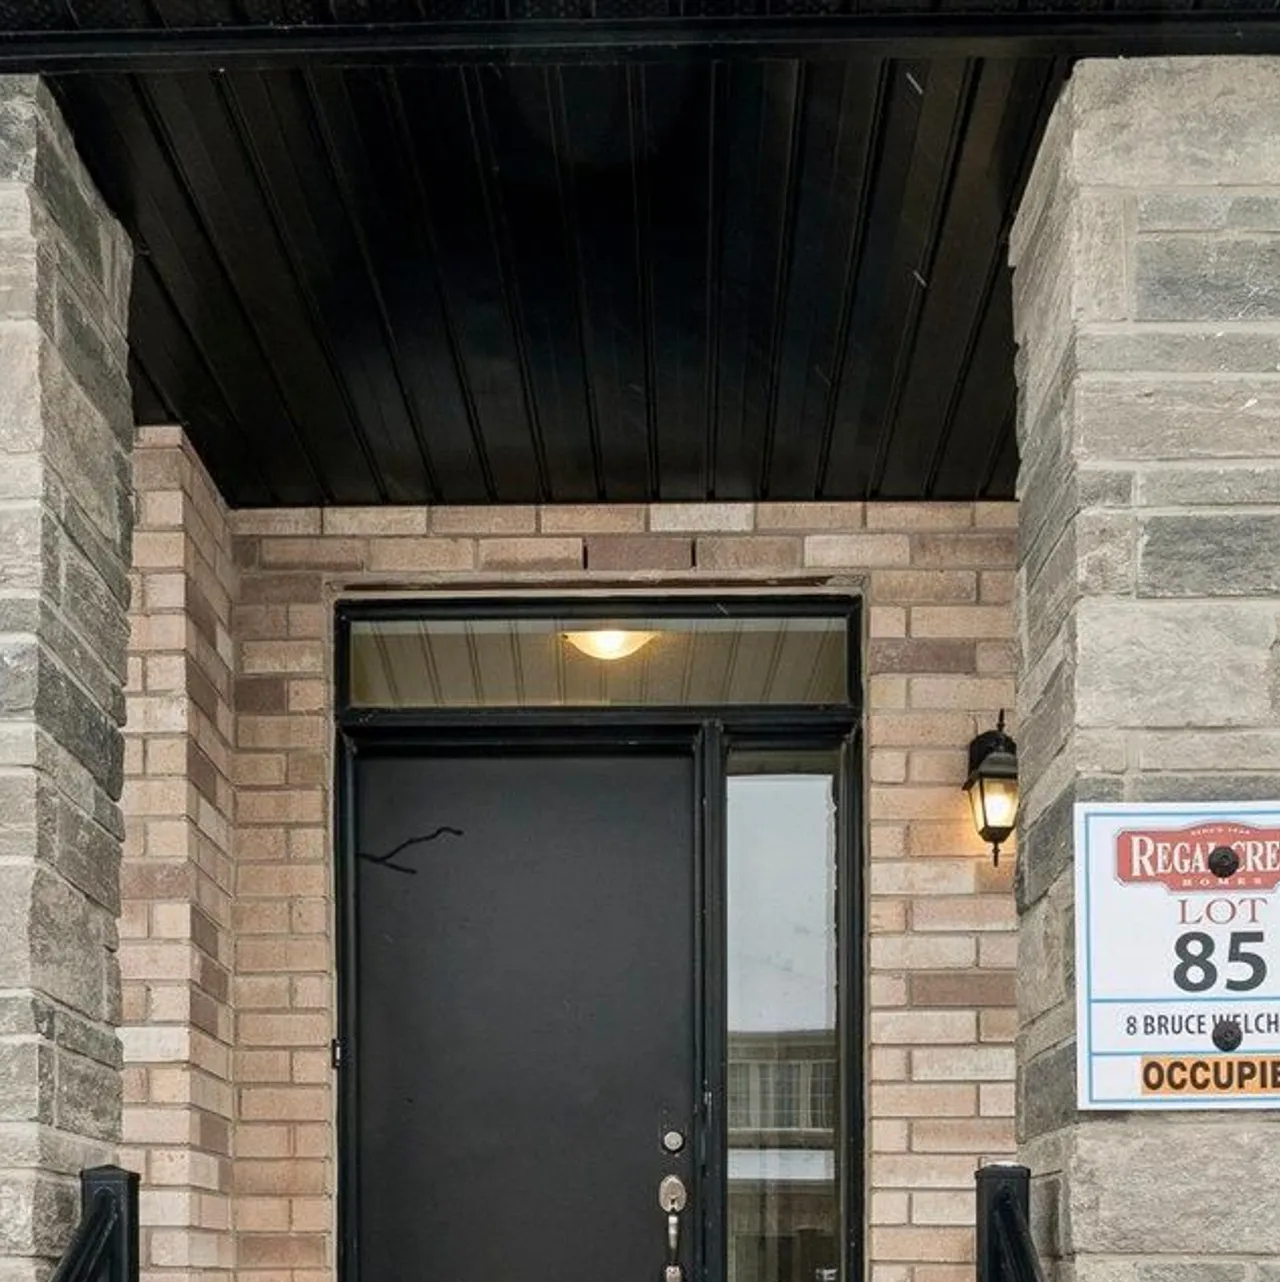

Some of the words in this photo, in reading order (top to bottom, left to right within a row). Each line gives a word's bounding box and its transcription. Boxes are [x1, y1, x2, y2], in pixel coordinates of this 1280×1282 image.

[1177, 897, 1269, 925] LOT
[1173, 930, 1268, 993] 85
[1125, 1015, 1138, 1036] 8
[1143, 1014, 1207, 1036] BRUCE
